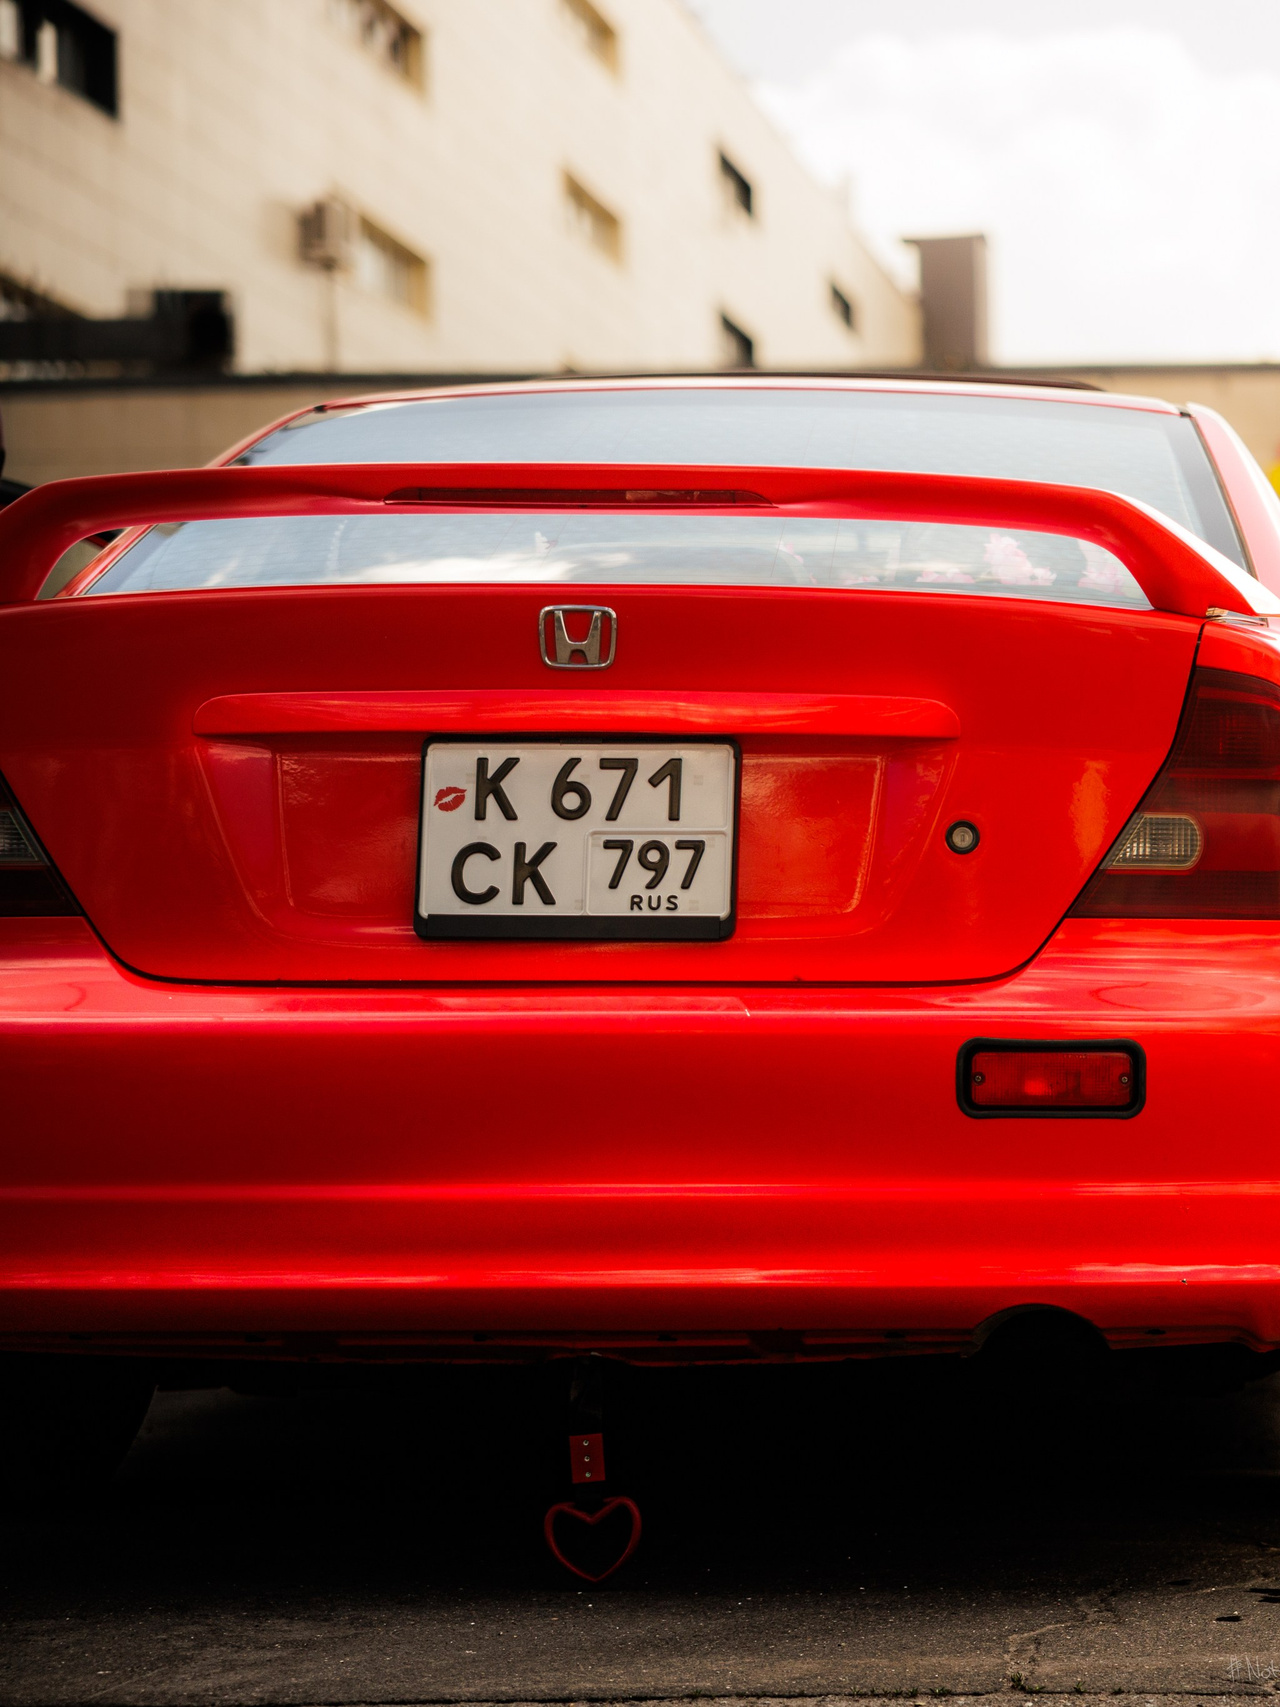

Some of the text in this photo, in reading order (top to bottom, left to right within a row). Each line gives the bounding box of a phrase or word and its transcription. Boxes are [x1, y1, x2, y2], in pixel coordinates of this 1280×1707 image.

[551, 757, 683, 821] 671
[603, 839, 705, 889] 797
[630, 894, 679, 911] RUS
